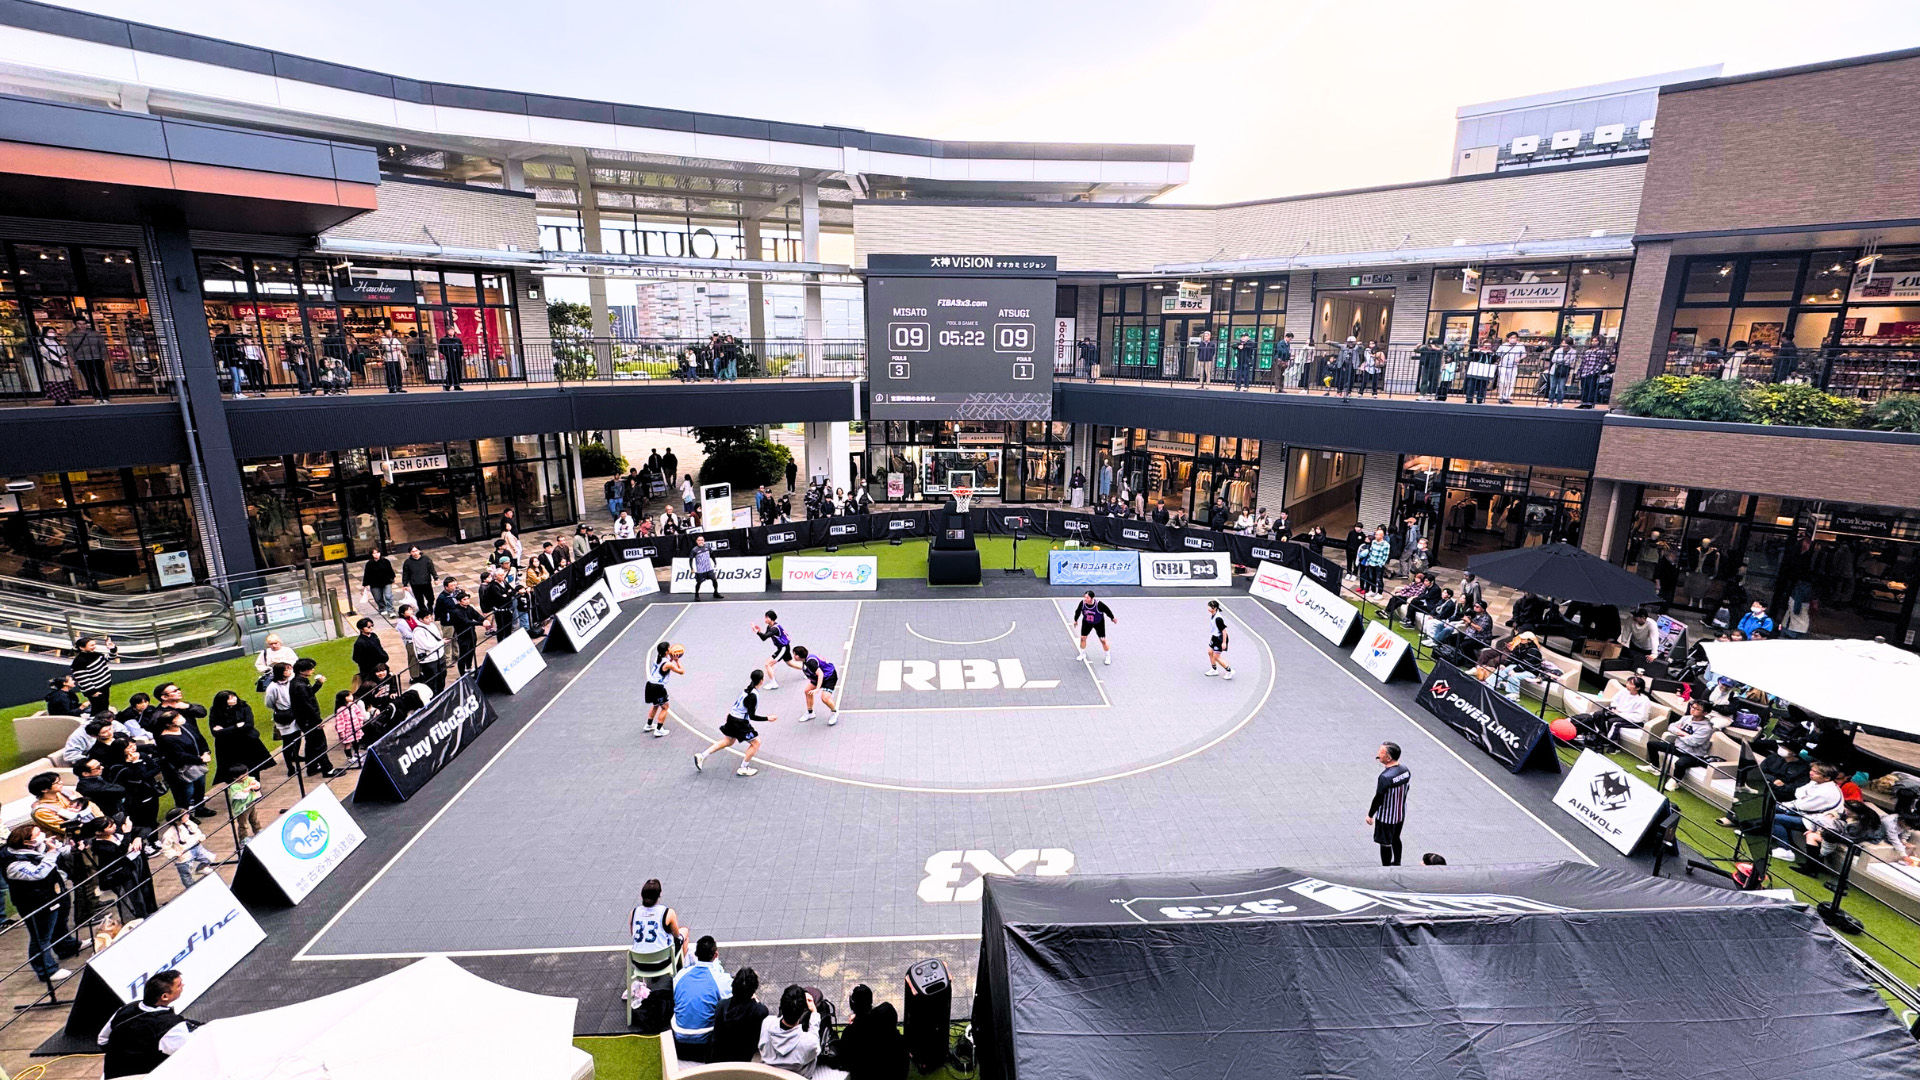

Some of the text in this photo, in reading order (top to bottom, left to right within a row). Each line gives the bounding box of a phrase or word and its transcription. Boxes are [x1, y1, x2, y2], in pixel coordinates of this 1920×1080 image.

[353, 281, 396, 294] Hawkins
[893, 308, 927, 317] MISATO
[998, 309, 1031, 318] ATSUGI
[895, 327, 924, 347] 09
[939, 331, 985, 346] 05:22
[1000, 329, 1028, 348] 09
[1058, 321, 1067, 359] docomo
[895, 365, 904, 376] 3
[1020, 366, 1027, 377] 1
[416, 456, 440, 469] GATE
[1156, 562, 1188, 576] RBL
[572, 608, 596, 631] RBL
[876, 658, 1062, 691] RBL
[398, 694, 480, 775] play fiba3x3
[1568, 798, 1622, 835] AIRWOLF
[304, 825, 327, 847] FSK
[634, 920, 658, 943] 33
